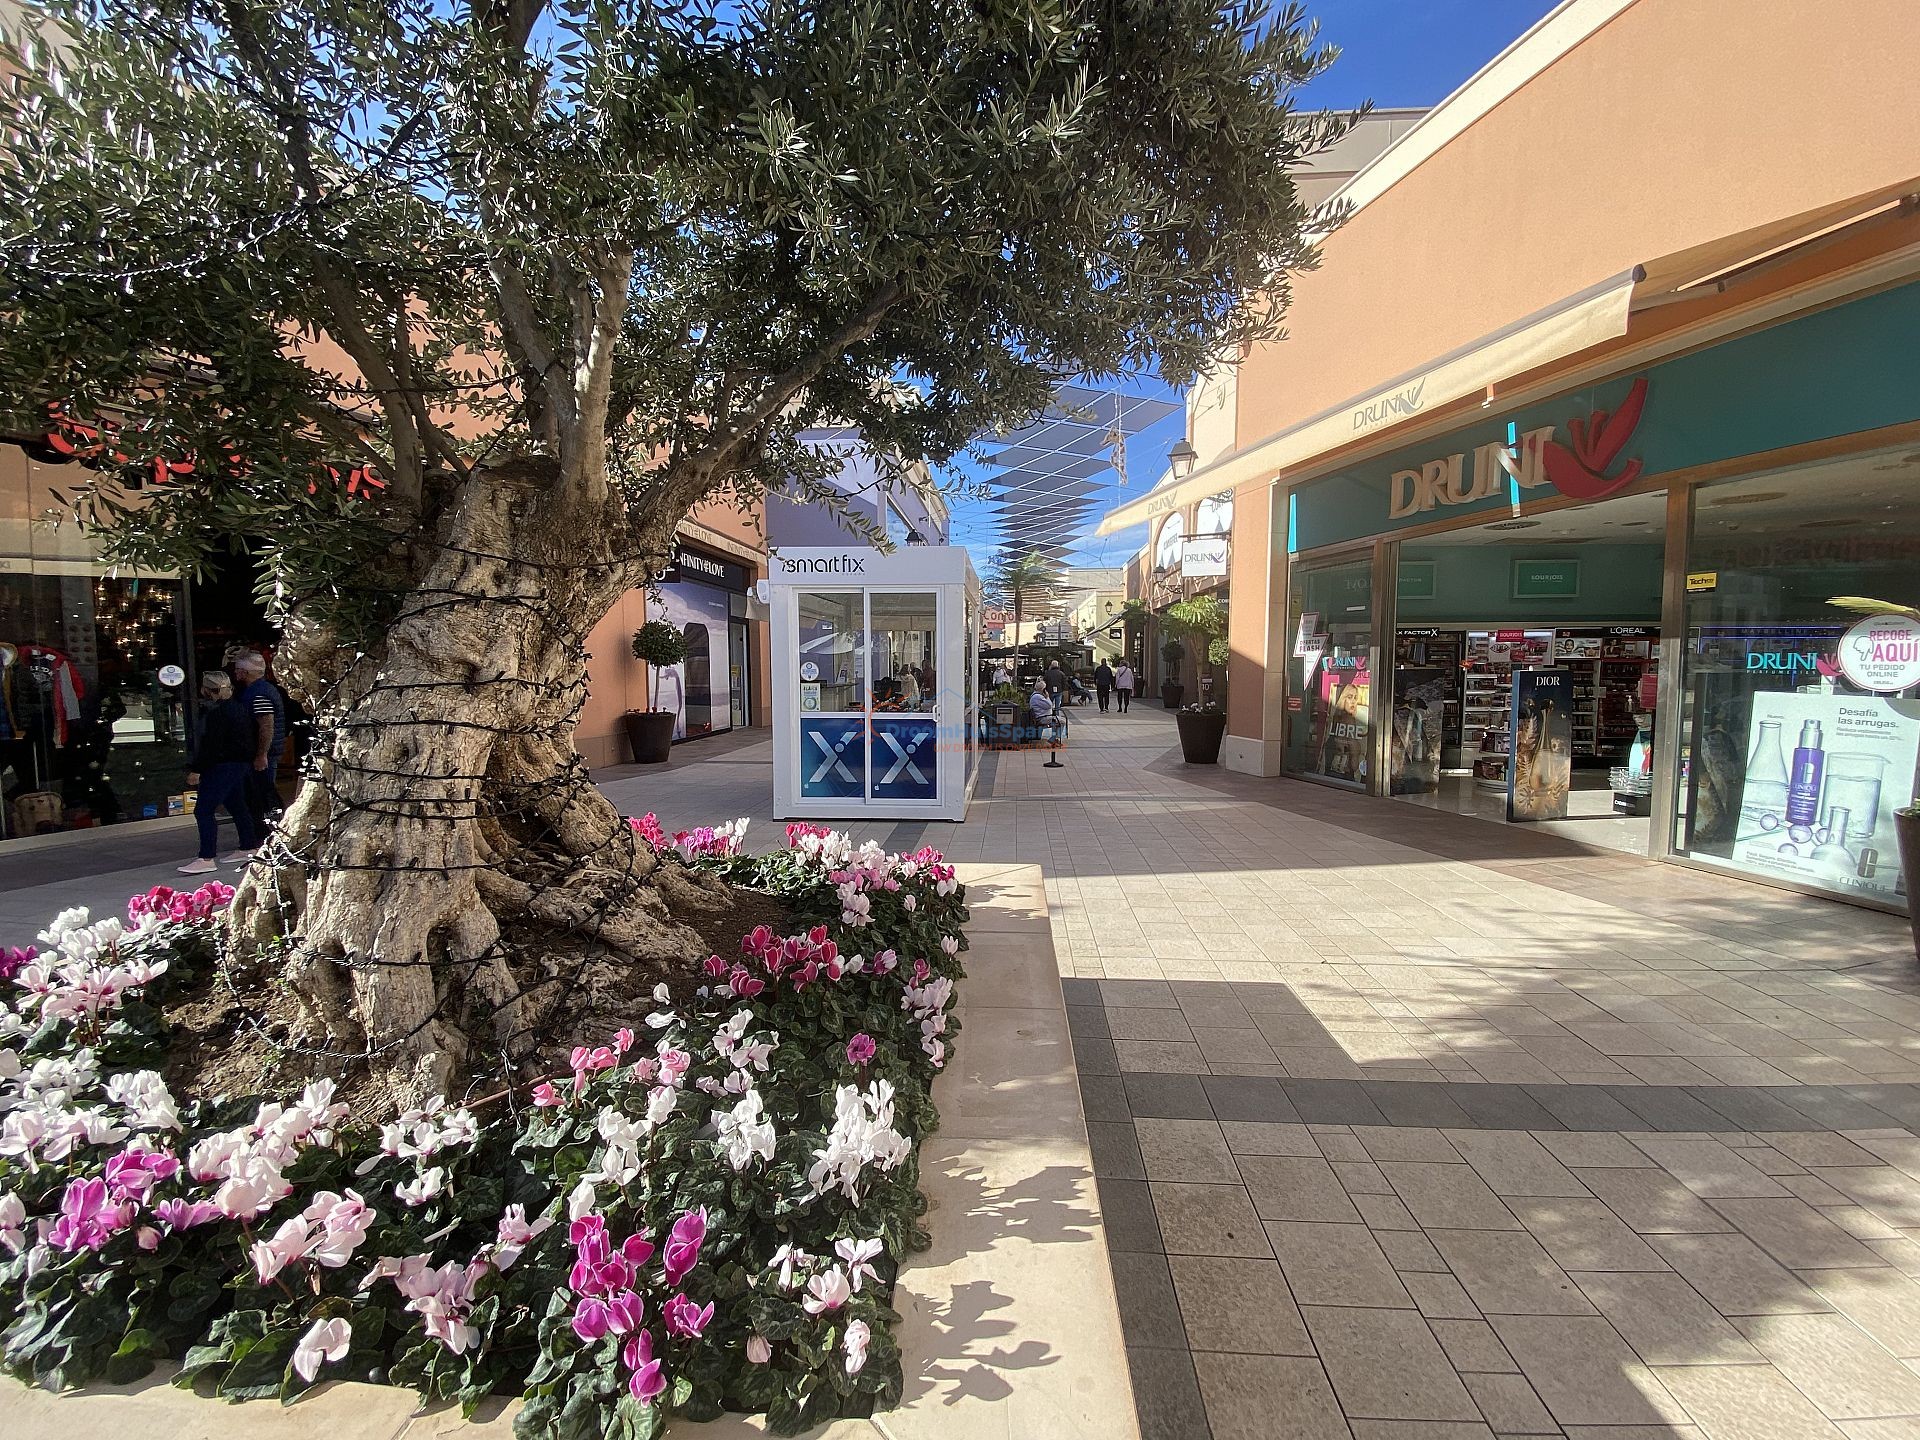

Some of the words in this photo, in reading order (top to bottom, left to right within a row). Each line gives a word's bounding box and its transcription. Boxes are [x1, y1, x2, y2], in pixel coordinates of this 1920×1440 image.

[1353, 393, 1402, 430] DRUNI
[1388, 427, 1556, 519] DRUNI
[680, 552, 703, 571] NFINITY
[1184, 552, 1213, 563] DRUNI
[1870, 629, 1912, 641] RECOGE
[1872, 638, 1920, 662] AQUÍ
[1746, 652, 1819, 670] DRUNI
[1536, 676, 1561, 686] DIOR
[1329, 722, 1364, 740] LIBRE
[1837, 717, 1853, 725] las
[1854, 719, 1900, 729] arrugas.
